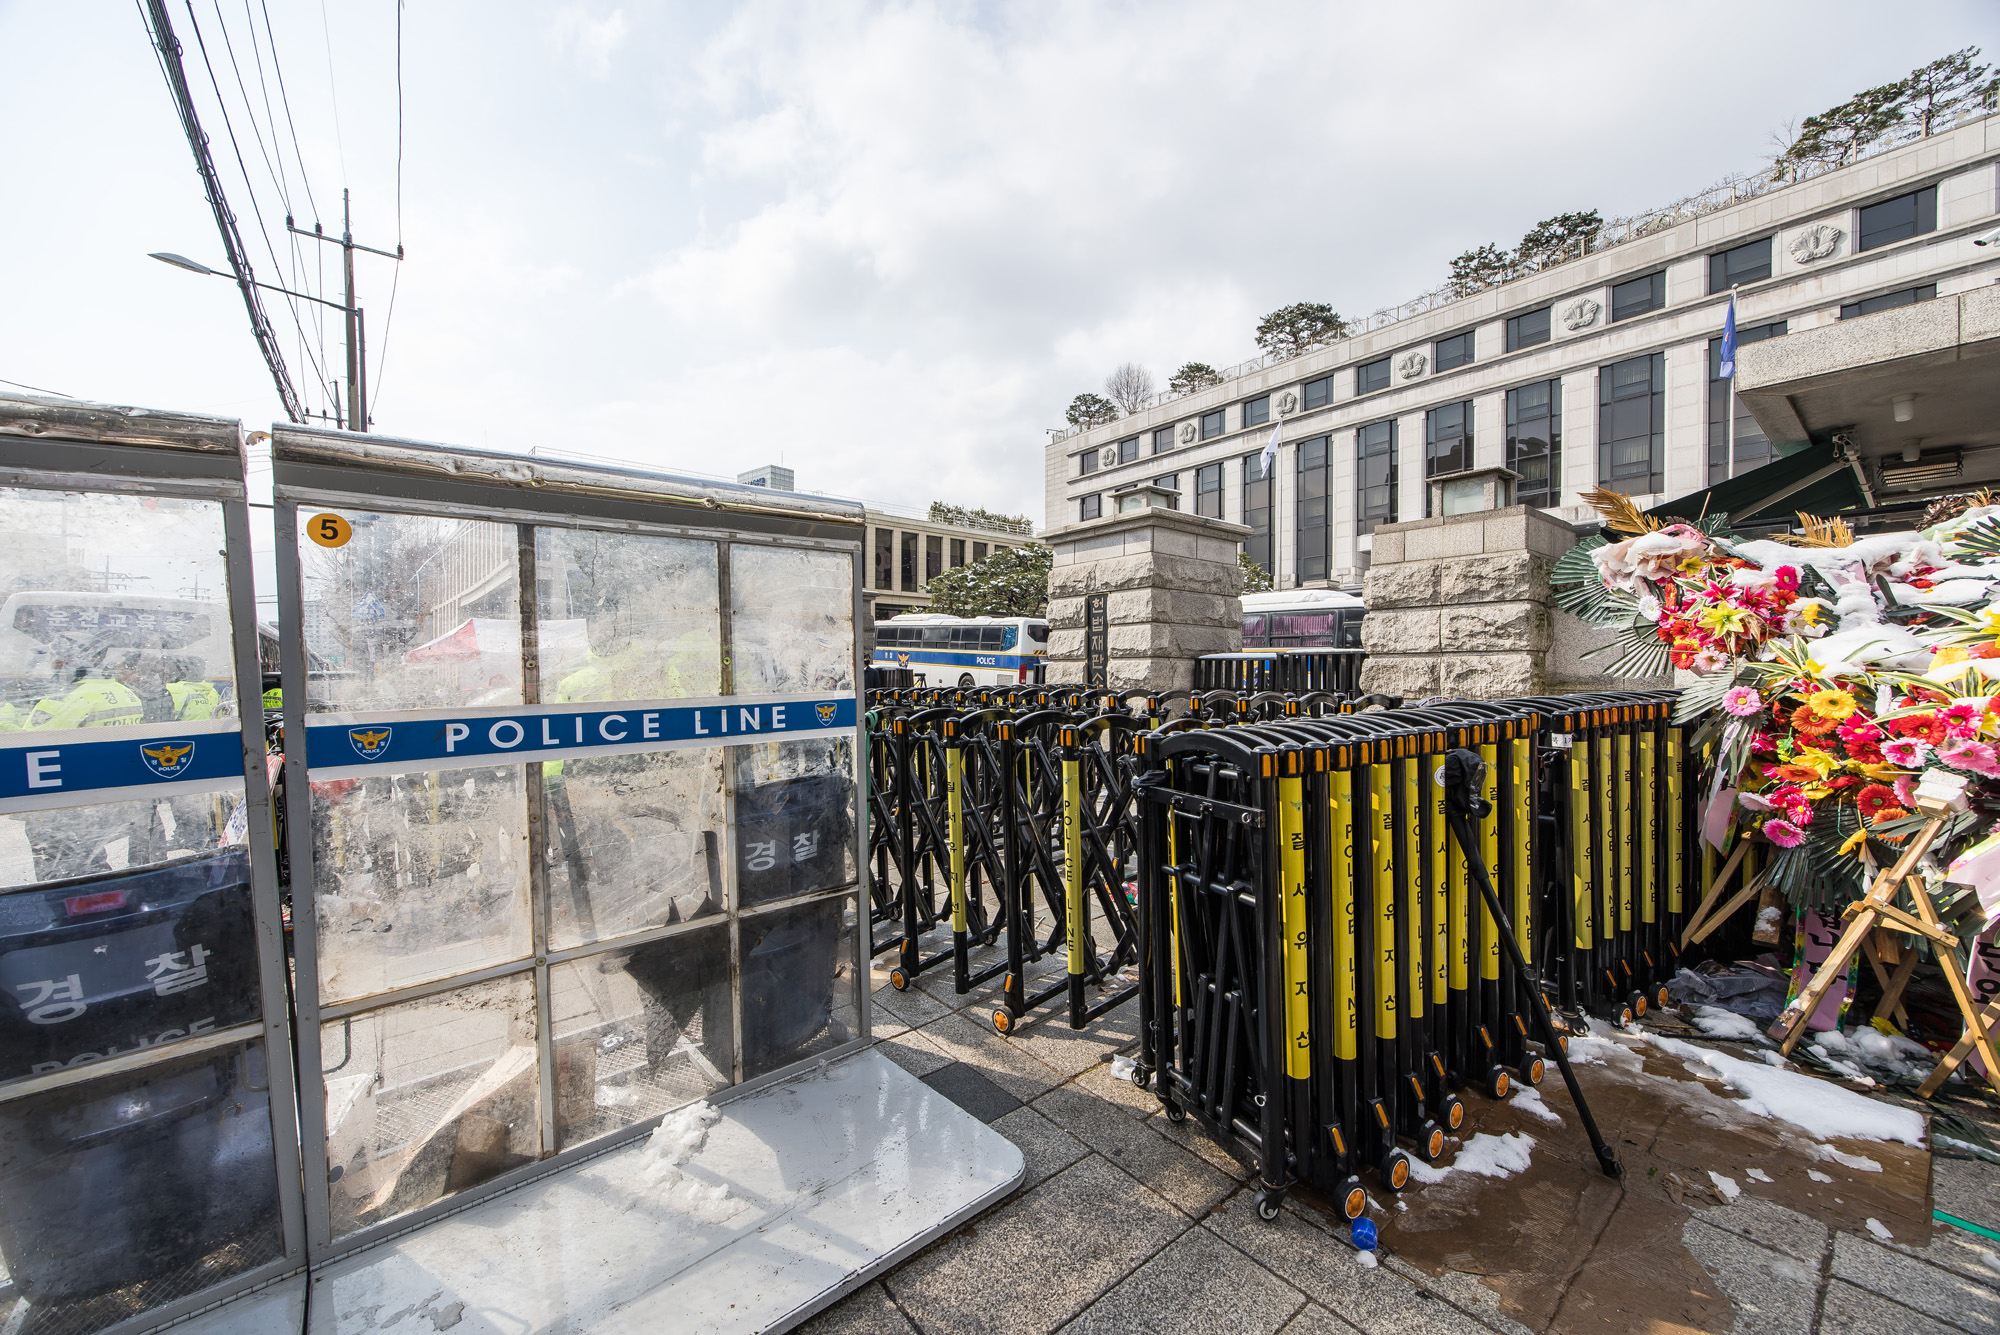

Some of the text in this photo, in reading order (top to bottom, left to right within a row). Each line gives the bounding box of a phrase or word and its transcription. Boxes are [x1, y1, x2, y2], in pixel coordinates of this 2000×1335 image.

[320, 519, 338, 540] 5
[976, 656, 995, 665] POLICE
[1091, 597, 1105, 692] 헌법재판소
[446, 706, 786, 753] POLICE LINE
[745, 829, 820, 871] 경찰
[1064, 801, 1072, 882] POLICE
[1489, 787, 1499, 956] 질서유선
[1291, 832, 1310, 1049] 질서유지선
[16, 943, 211, 1025] 경찰
